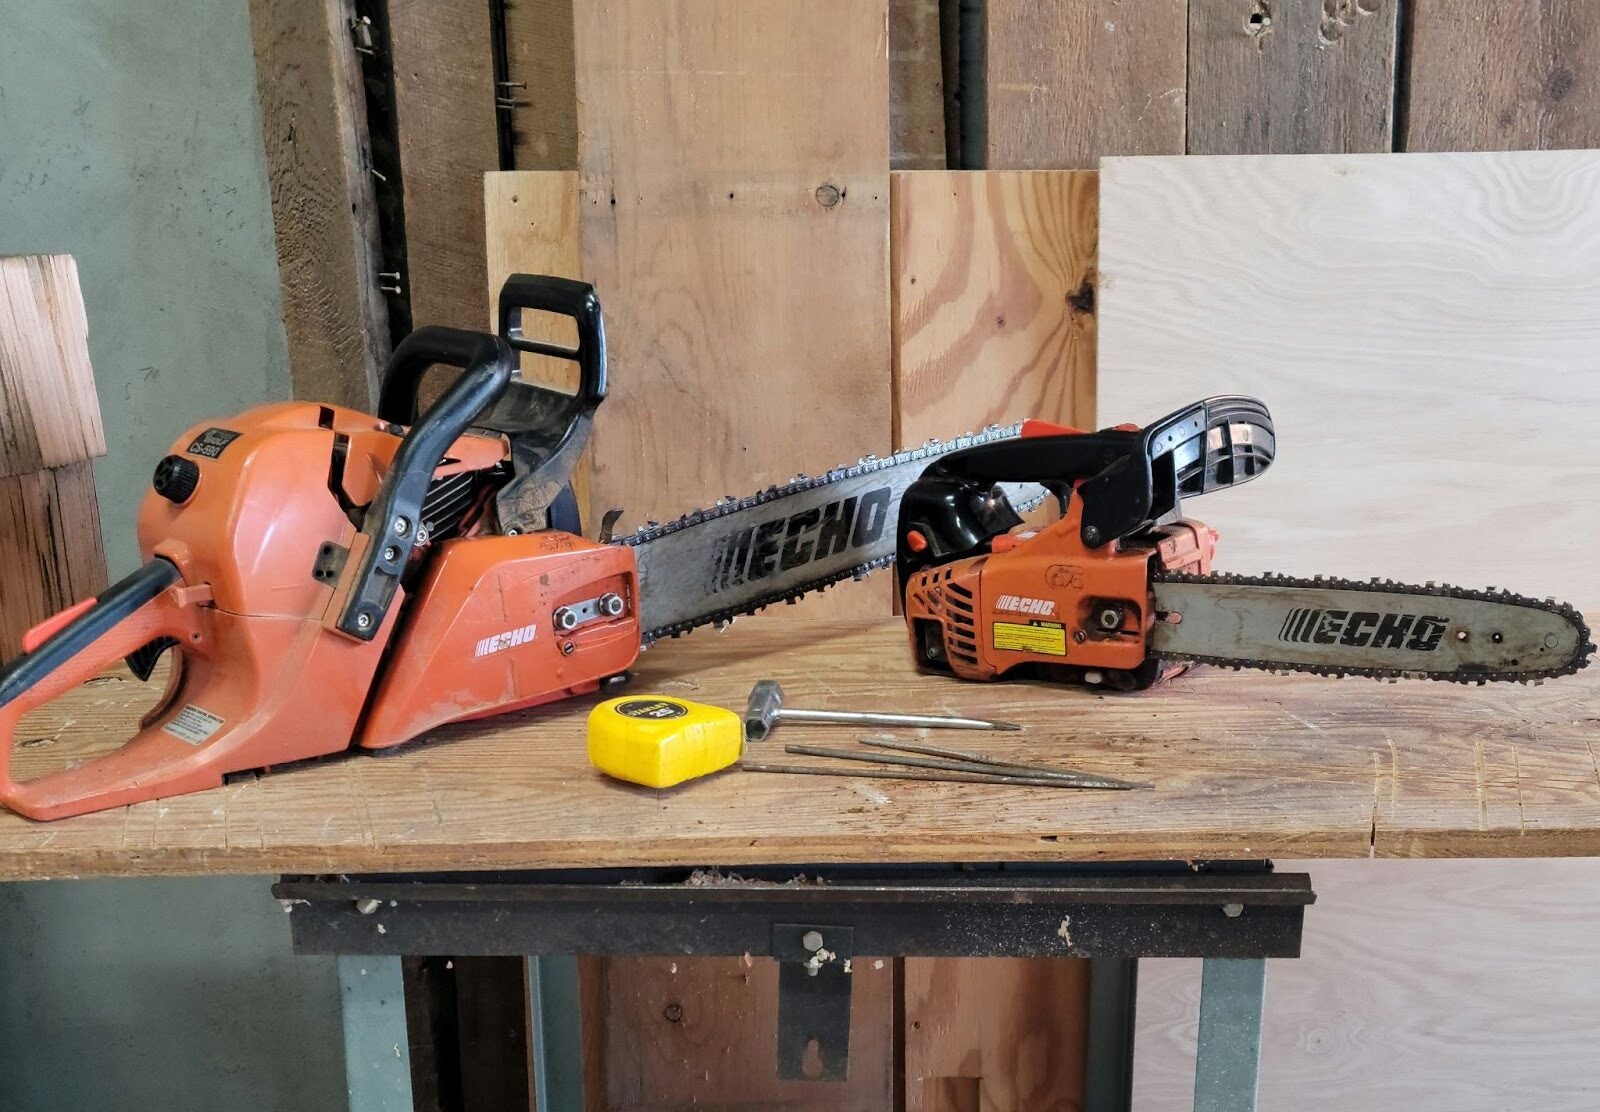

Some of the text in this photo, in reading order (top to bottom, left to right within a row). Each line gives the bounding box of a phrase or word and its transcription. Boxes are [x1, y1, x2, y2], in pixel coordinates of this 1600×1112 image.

[190, 442, 220, 457] CS-590
[749, 487, 892, 582] ECHO
[1009, 597, 1056, 616] ECHO
[488, 624, 537, 653] ECHO
[1313, 609, 1450, 652] ECHO
